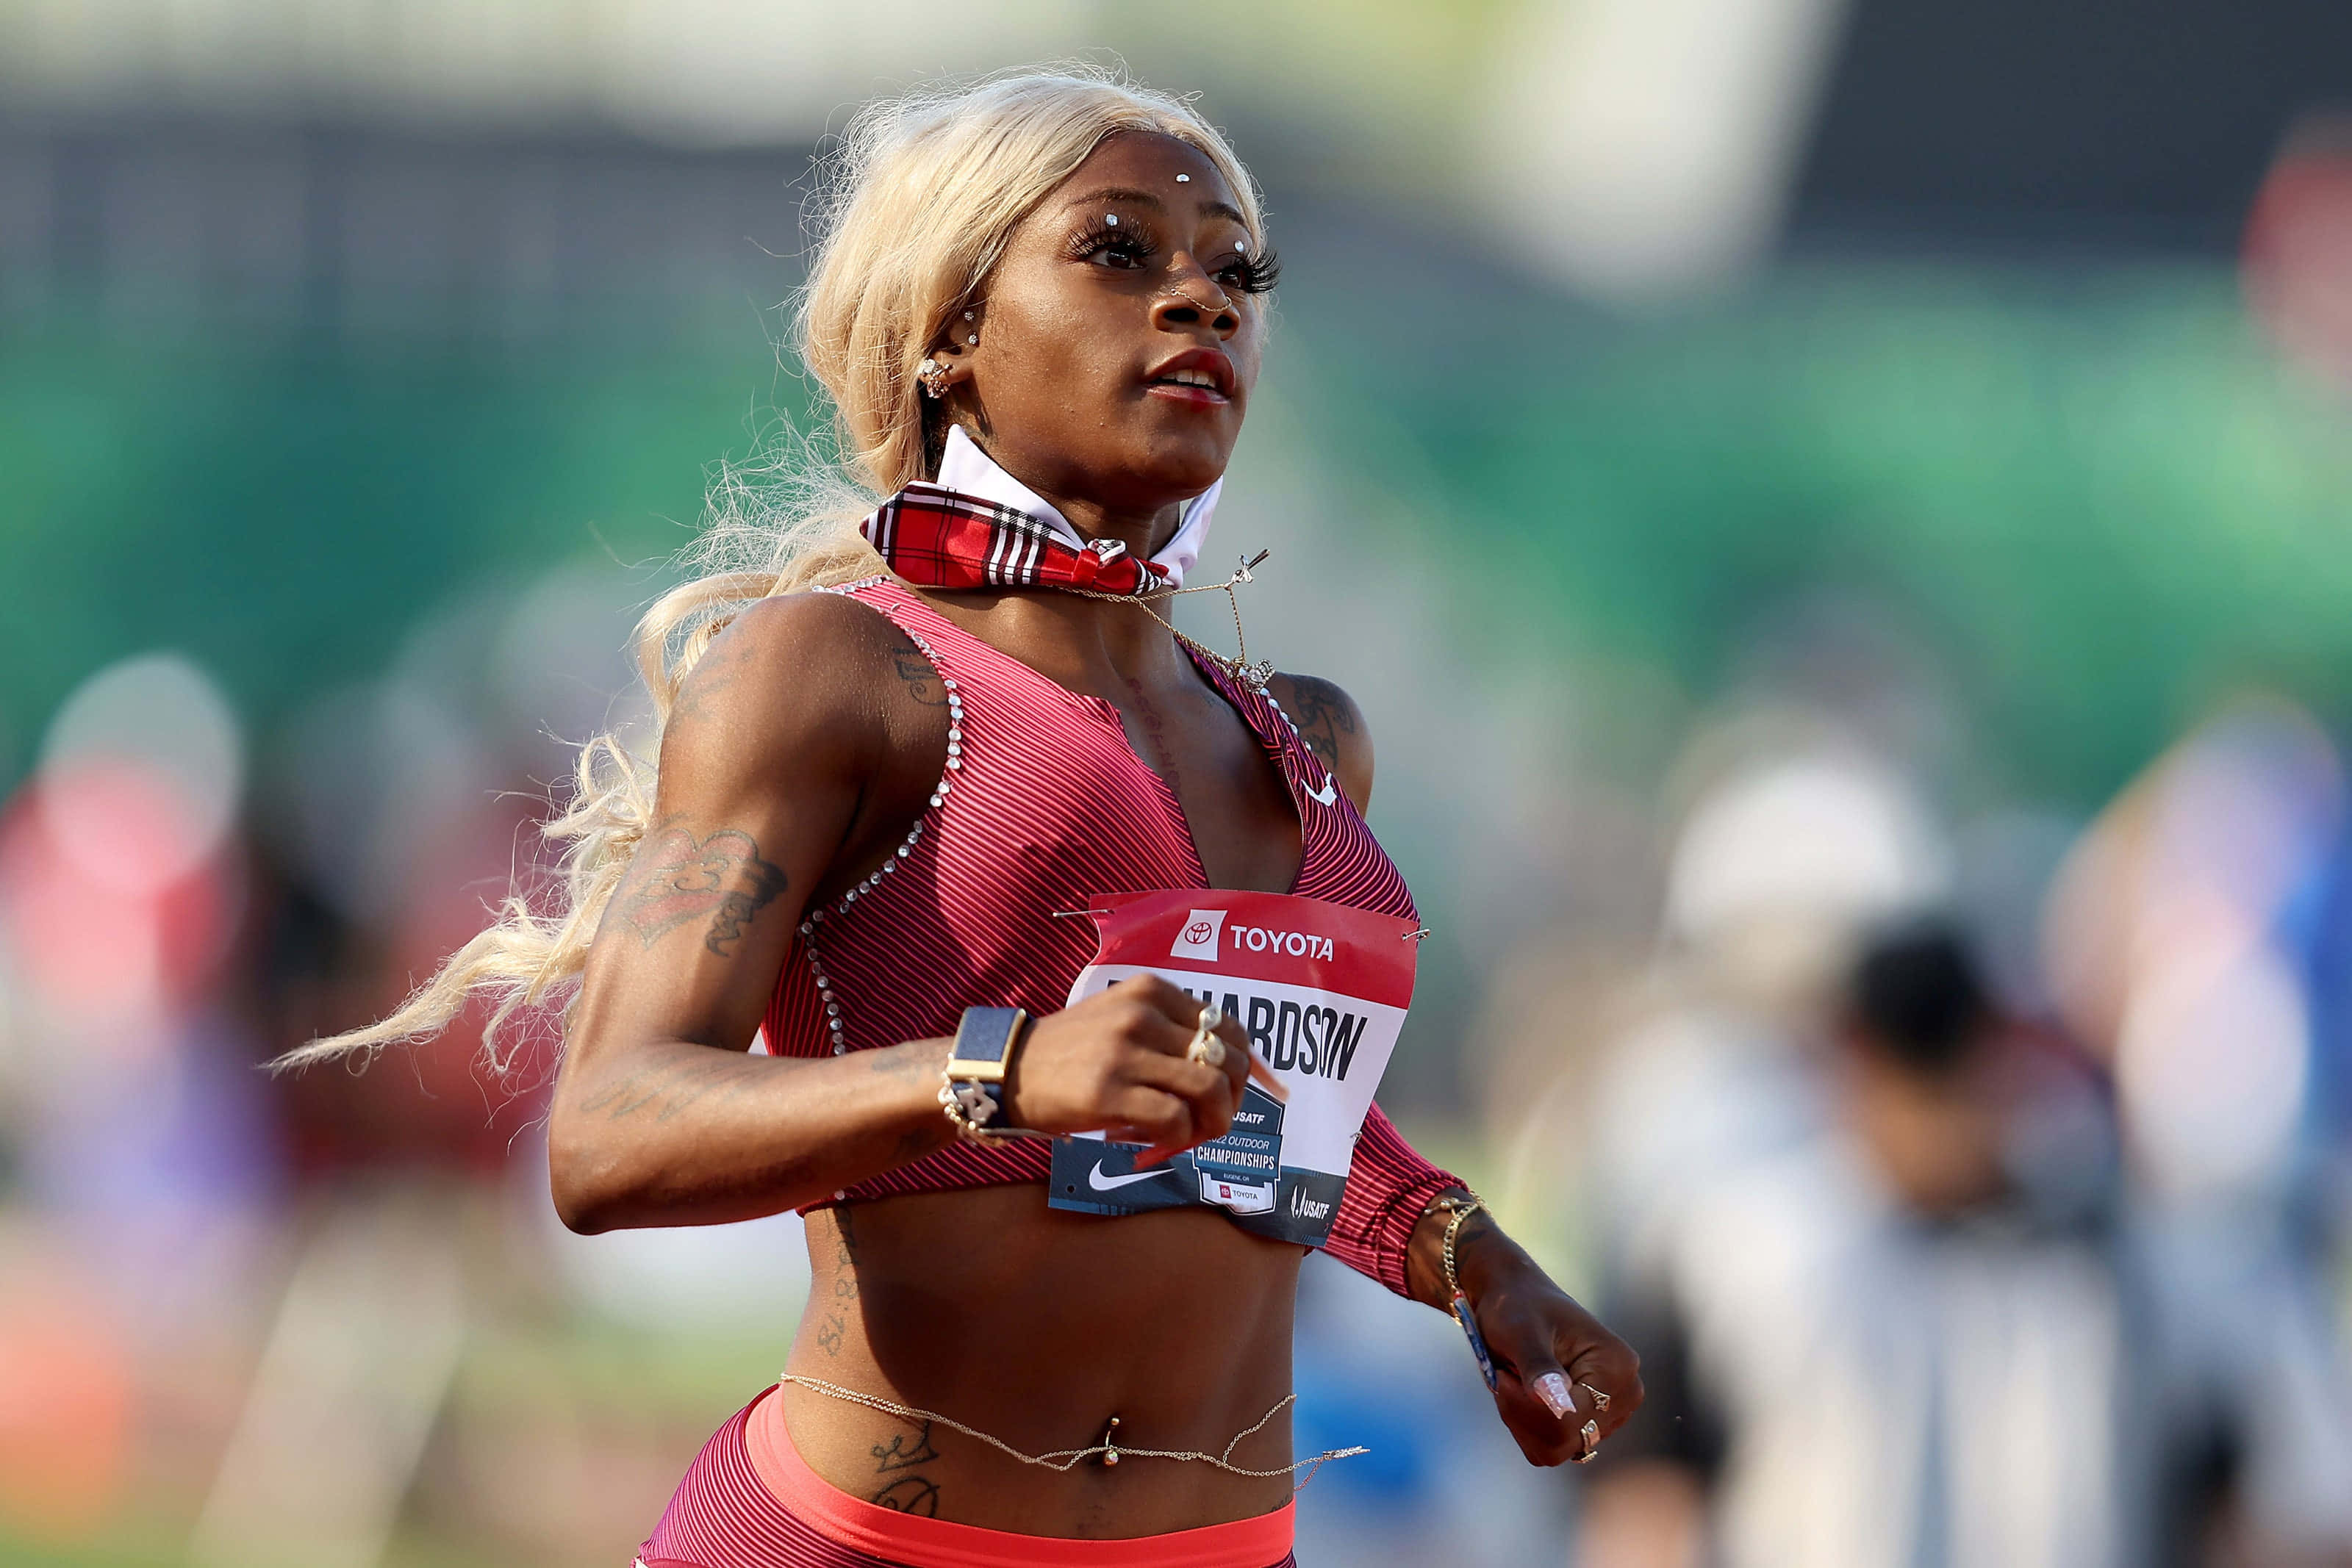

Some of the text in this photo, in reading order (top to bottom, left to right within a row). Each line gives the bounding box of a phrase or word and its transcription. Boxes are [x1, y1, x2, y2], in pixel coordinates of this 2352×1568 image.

[1230, 924, 1334, 962] TOYOTA
[1107, 979, 1369, 1082] RDSON
[1207, 1135, 1270, 1150] 22 OUTDOOR
[1197, 1146, 1274, 1170] CHAMPIONSHIPS
[1232, 1190, 1258, 1200] TOYOTA
[1303, 1199, 1330, 1220] USATF
